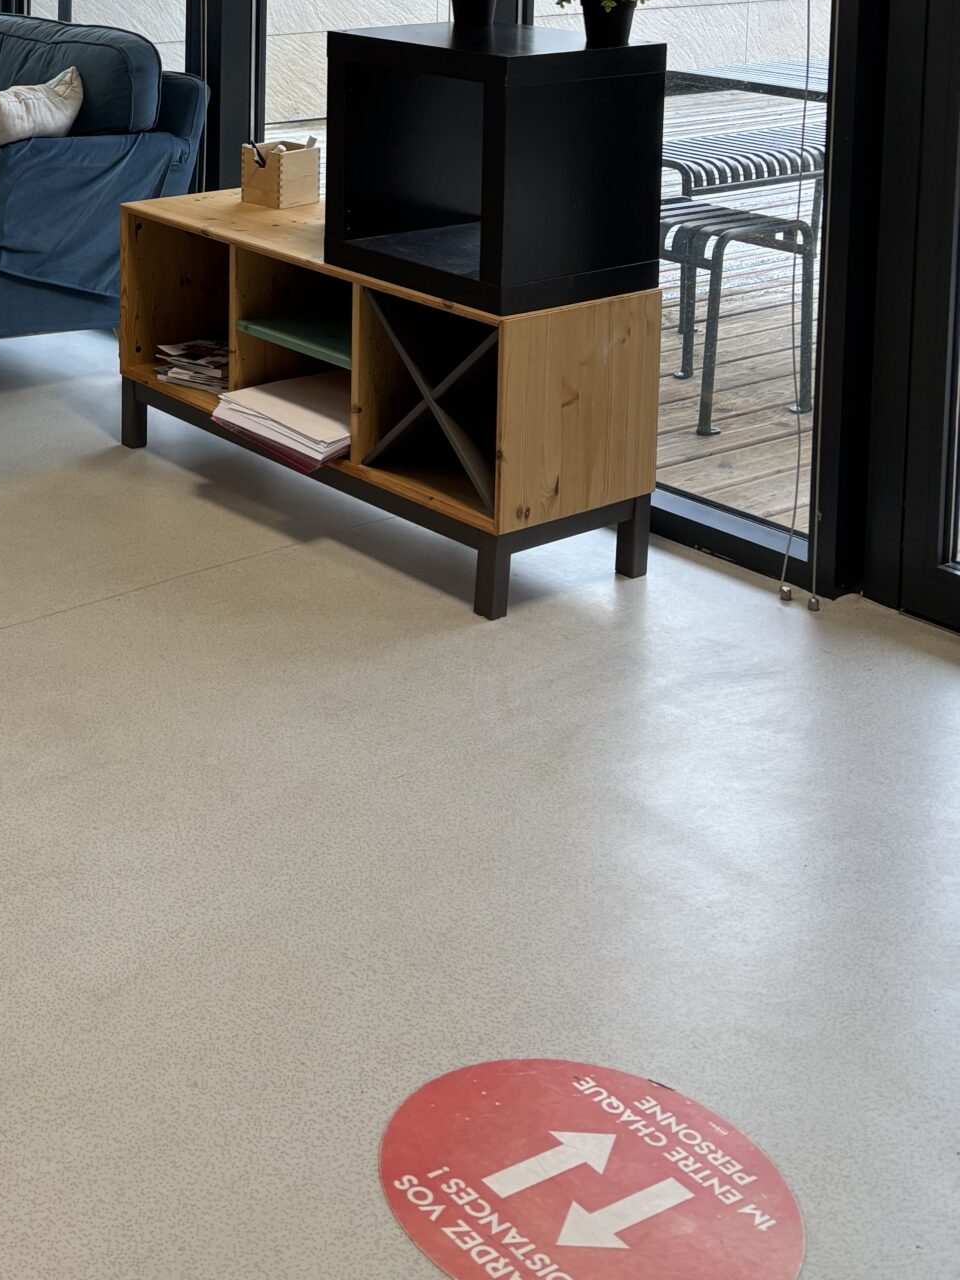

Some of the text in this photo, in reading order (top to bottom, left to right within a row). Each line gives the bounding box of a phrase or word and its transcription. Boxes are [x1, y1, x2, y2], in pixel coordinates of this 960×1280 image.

[572, 1077, 777, 1231] 1M ENTRE CHAQUE
[633, 1096, 758, 1185] PERSONNE
[394, 1175, 522, 1280] RDEZ VOS
